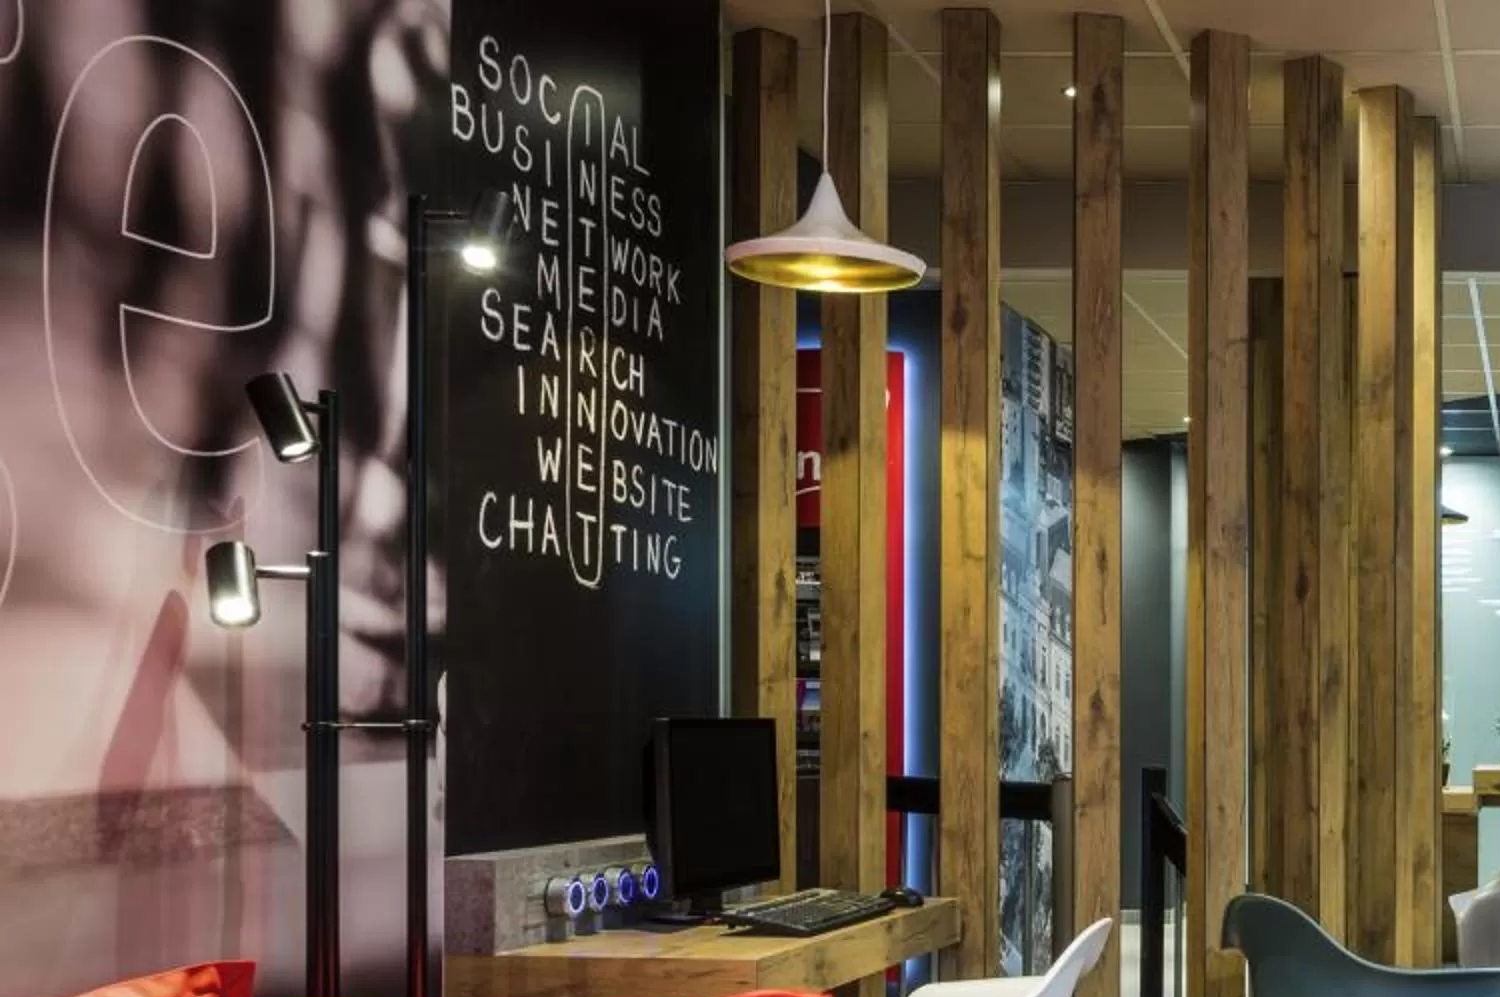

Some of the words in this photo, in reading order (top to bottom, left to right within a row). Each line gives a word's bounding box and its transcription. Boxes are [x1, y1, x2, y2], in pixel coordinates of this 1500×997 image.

[451, 83, 662, 237] BUSINESS
[479, 35, 650, 176] SOCIAL
[512, 182, 681, 305] NETWORK
[537, 252, 663, 342] MEDIA
[481, 288, 645, 398] SEARCH
[518, 365, 718, 474] INNOVATION
[537, 436, 692, 522] WEBSITE
[478, 492, 682, 580] CHATTING
